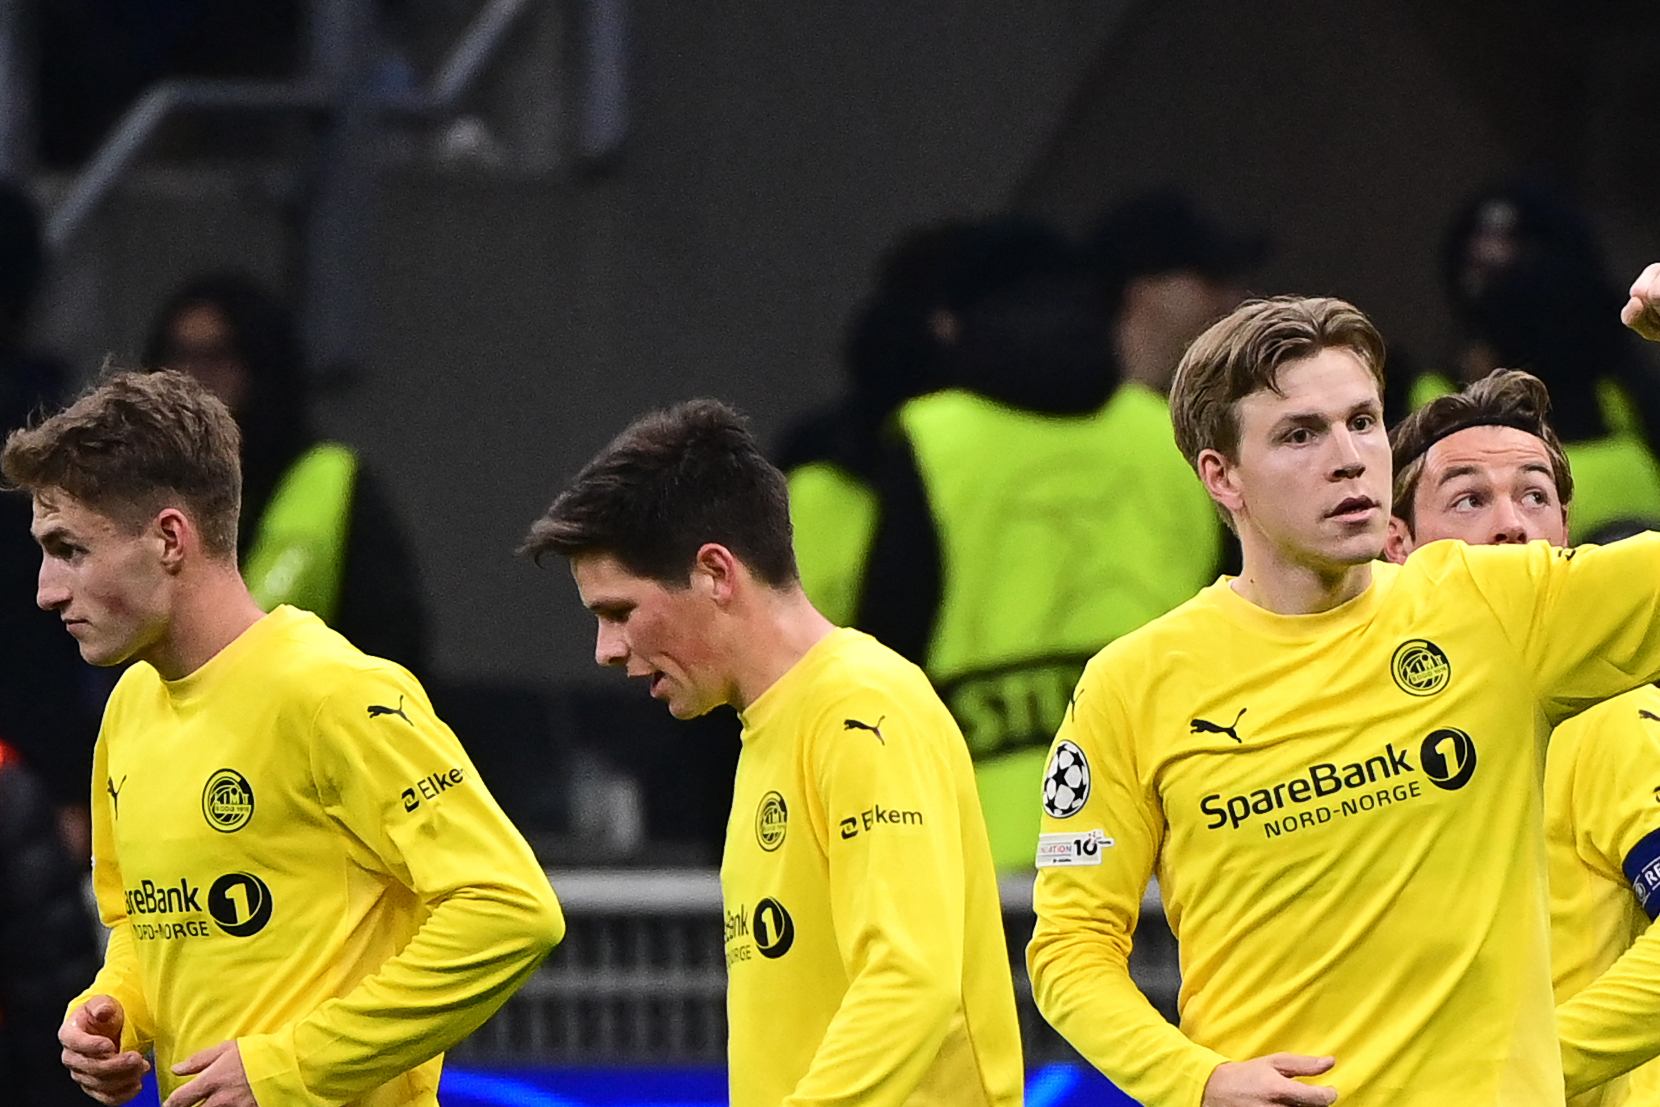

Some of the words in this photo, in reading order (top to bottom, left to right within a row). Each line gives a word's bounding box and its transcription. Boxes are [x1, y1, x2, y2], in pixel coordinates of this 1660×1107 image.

[417, 768, 466, 800] Elke
[1200, 743, 1415, 830] SpareBank
[861, 803, 923, 832] Ekem
[1263, 781, 1422, 838] NORD-NORGE
